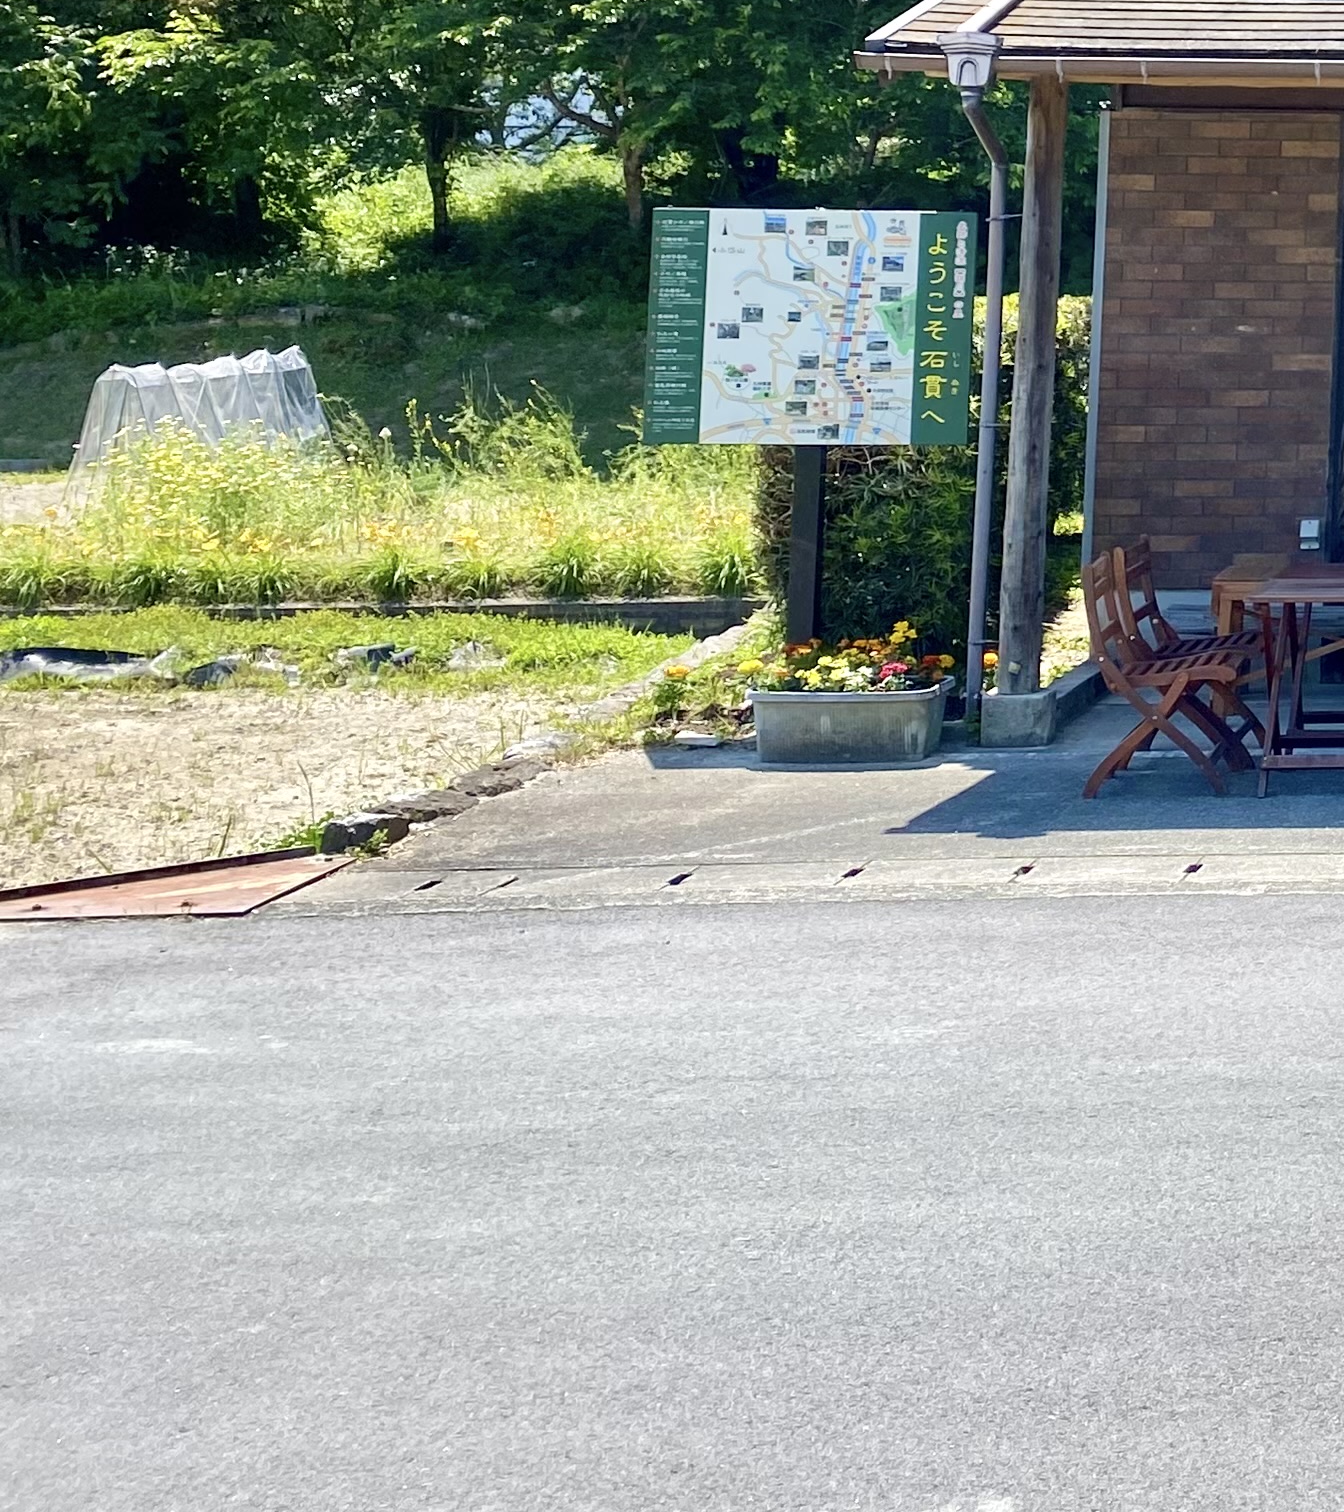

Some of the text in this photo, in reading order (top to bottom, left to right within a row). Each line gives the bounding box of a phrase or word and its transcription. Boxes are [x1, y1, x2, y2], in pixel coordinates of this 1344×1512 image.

[919, 232, 949, 424] ようこそ石貫へ
